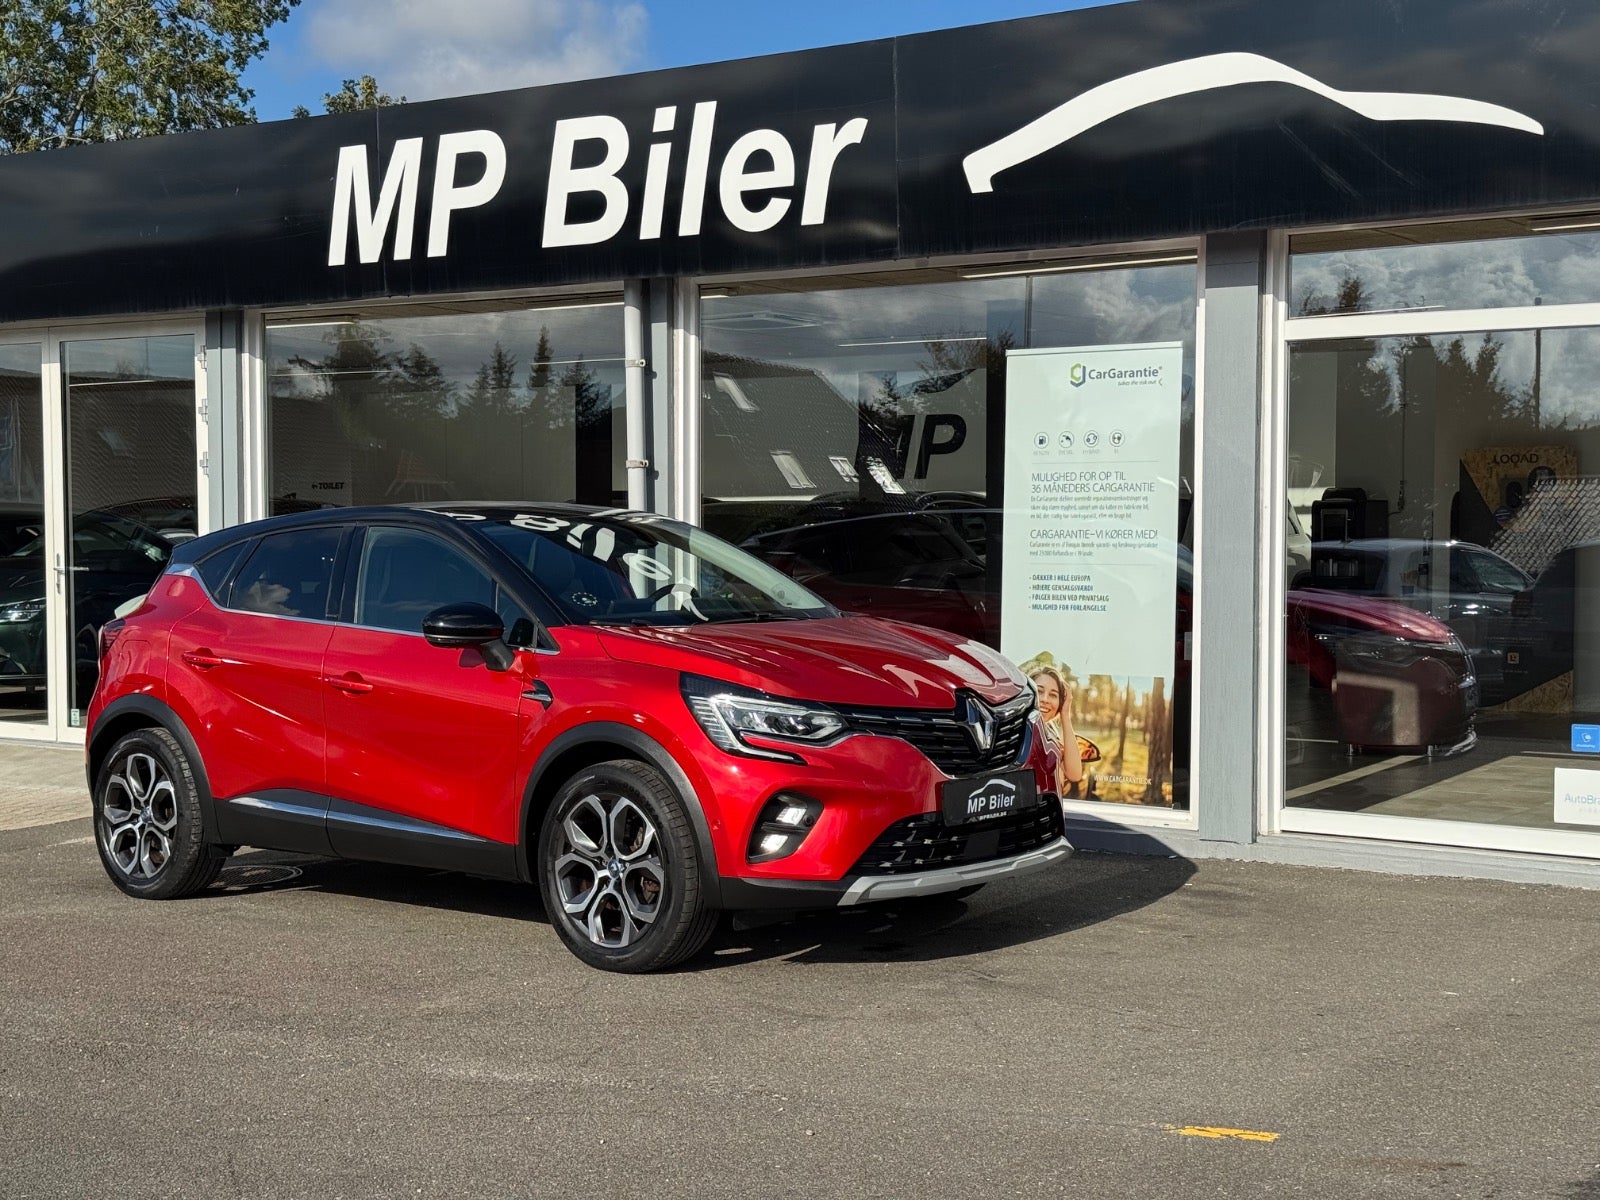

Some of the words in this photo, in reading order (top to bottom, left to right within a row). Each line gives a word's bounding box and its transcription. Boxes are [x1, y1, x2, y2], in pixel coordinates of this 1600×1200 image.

[328, 129, 507, 267] MP
[541, 100, 869, 248] Biler
[1031, 471, 1078, 482] MULIGHED
[1079, 471, 1097, 481] FOR
[1098, 471, 1112, 481] OP
[1114, 471, 1127, 481] TIL
[318, 482, 345, 490] TOILET
[1031, 484, 1041, 494] 36
[1043, 481, 1091, 493] MÅNEDERS
[1092, 482, 1156, 493] CARGARANTIE
[1105, 529, 1134, 539] KØRER
[967, 796, 986, 814] MP
[989, 793, 1016, 810] Biler
